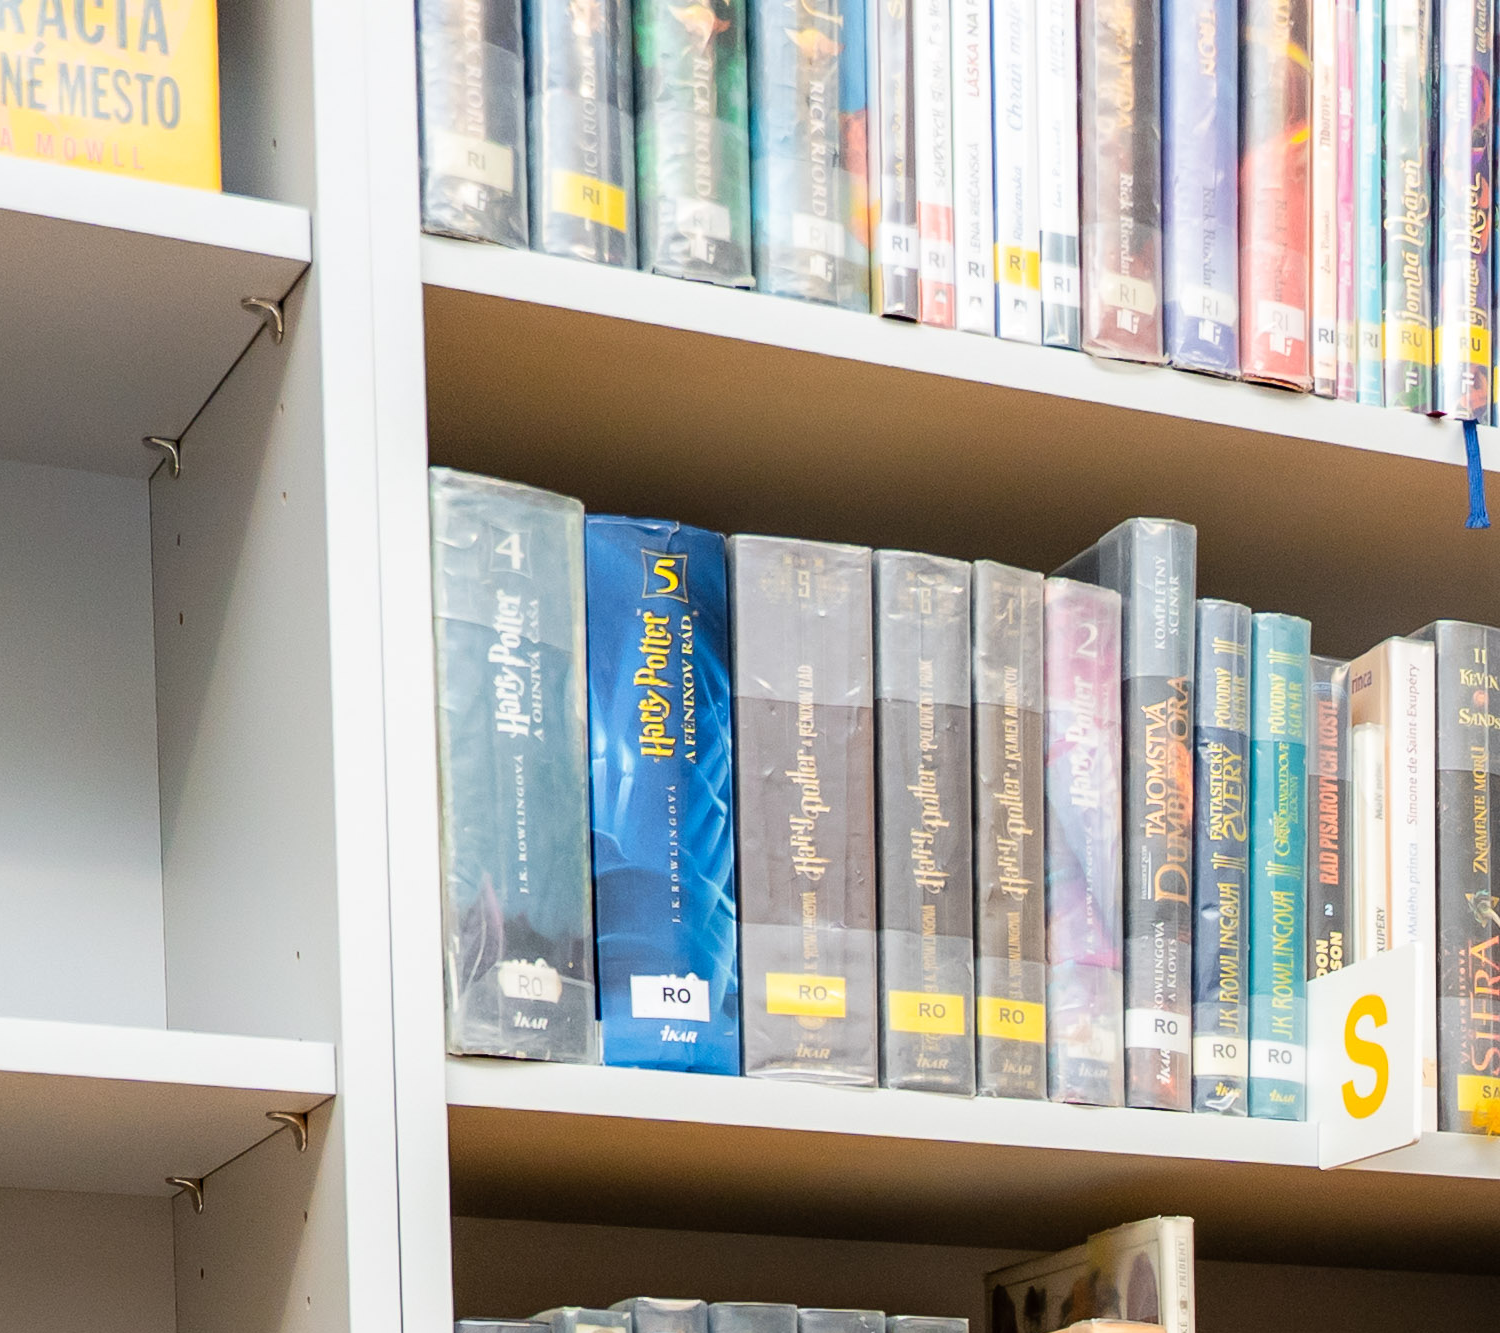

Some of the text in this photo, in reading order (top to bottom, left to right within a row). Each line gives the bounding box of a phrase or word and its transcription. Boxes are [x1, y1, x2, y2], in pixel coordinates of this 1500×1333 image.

[56, 64, 182, 131] MESTO
[494, 532, 525, 571] 4
[654, 554, 680, 596] 5
[632, 610, 675, 763] Harry Potter
[681, 614, 695, 763] A FÉNIXOV RÁD
[1145, 701, 1168, 837] TAJOMSTVÁ
[1472, 746, 1489, 875] ZNAMENIE MORU
[662, 987, 691, 1005] RO
[1341, 994, 1389, 1120] S
